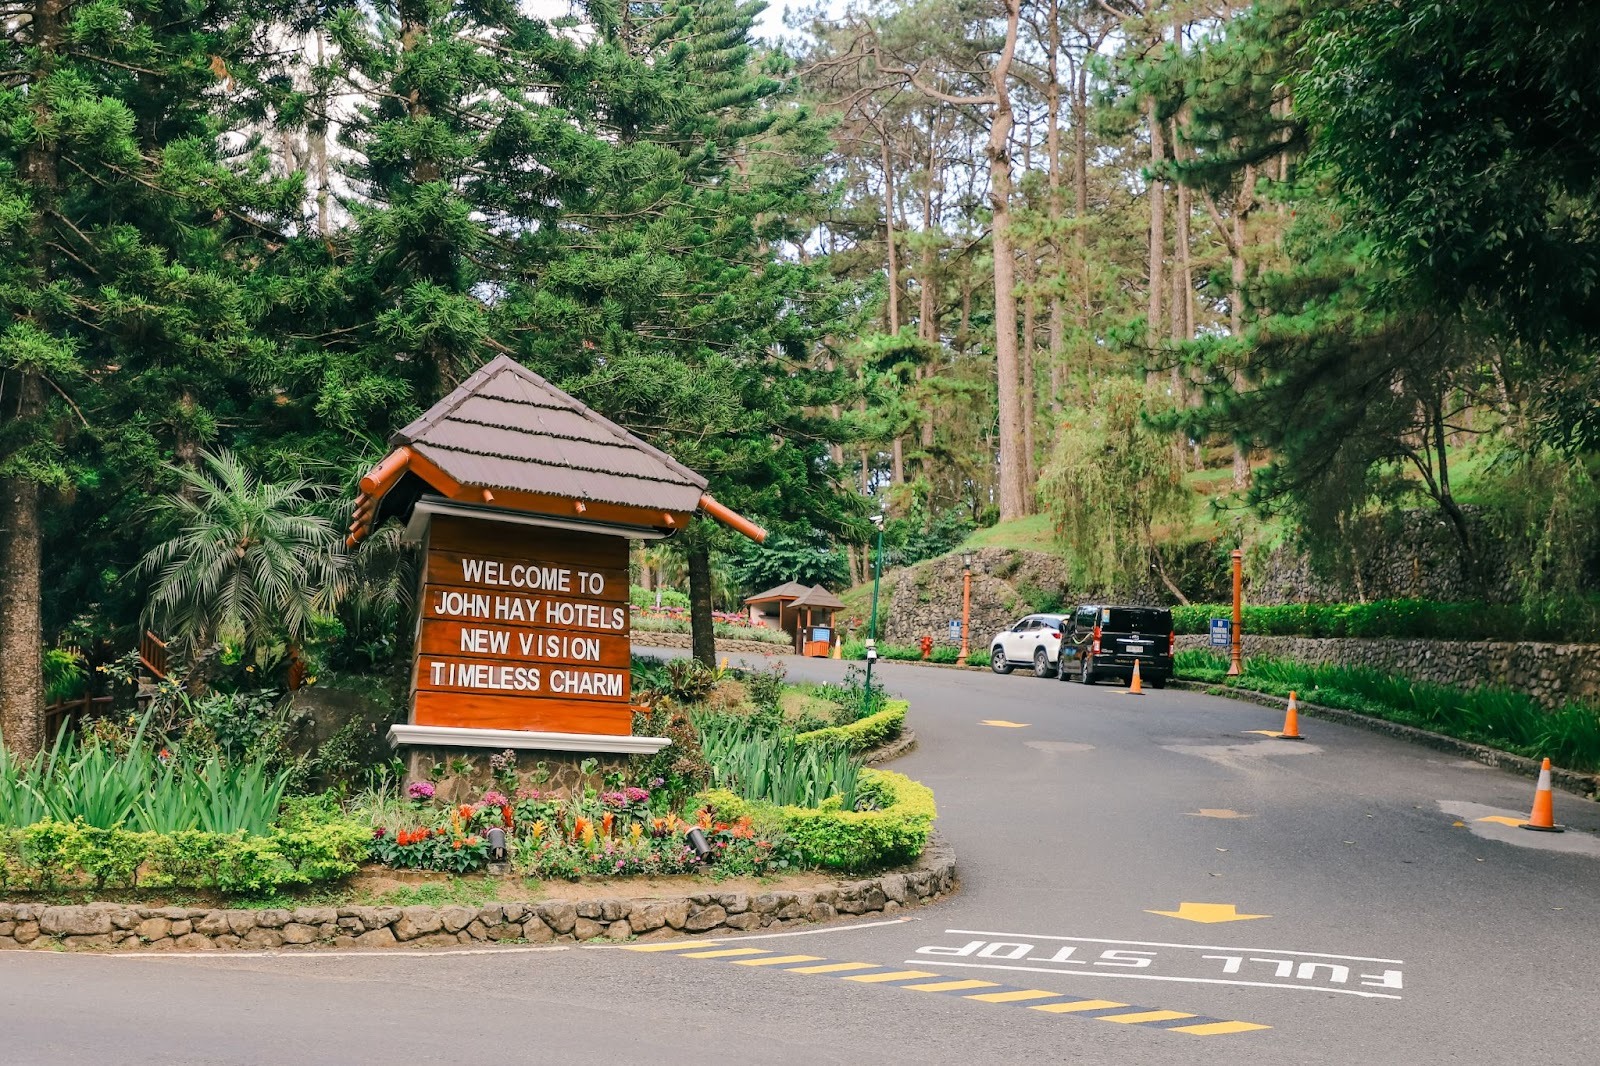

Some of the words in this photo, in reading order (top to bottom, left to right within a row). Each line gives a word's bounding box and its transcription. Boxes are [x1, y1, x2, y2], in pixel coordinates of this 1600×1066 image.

[462, 559, 570, 592] WELCOME
[578, 571, 604, 595] TO
[435, 592, 490, 618] JOHN
[495, 596, 540, 621] HAY
[546, 601, 625, 630] HOTELS
[461, 628, 510, 654] NEW
[519, 633, 600, 661] VISION
[431, 662, 540, 690] TIMELESS
[550, 670, 623, 696] CHARM
[915, 940, 1157, 967] STOP
[1202, 955, 1403, 989] FULL
